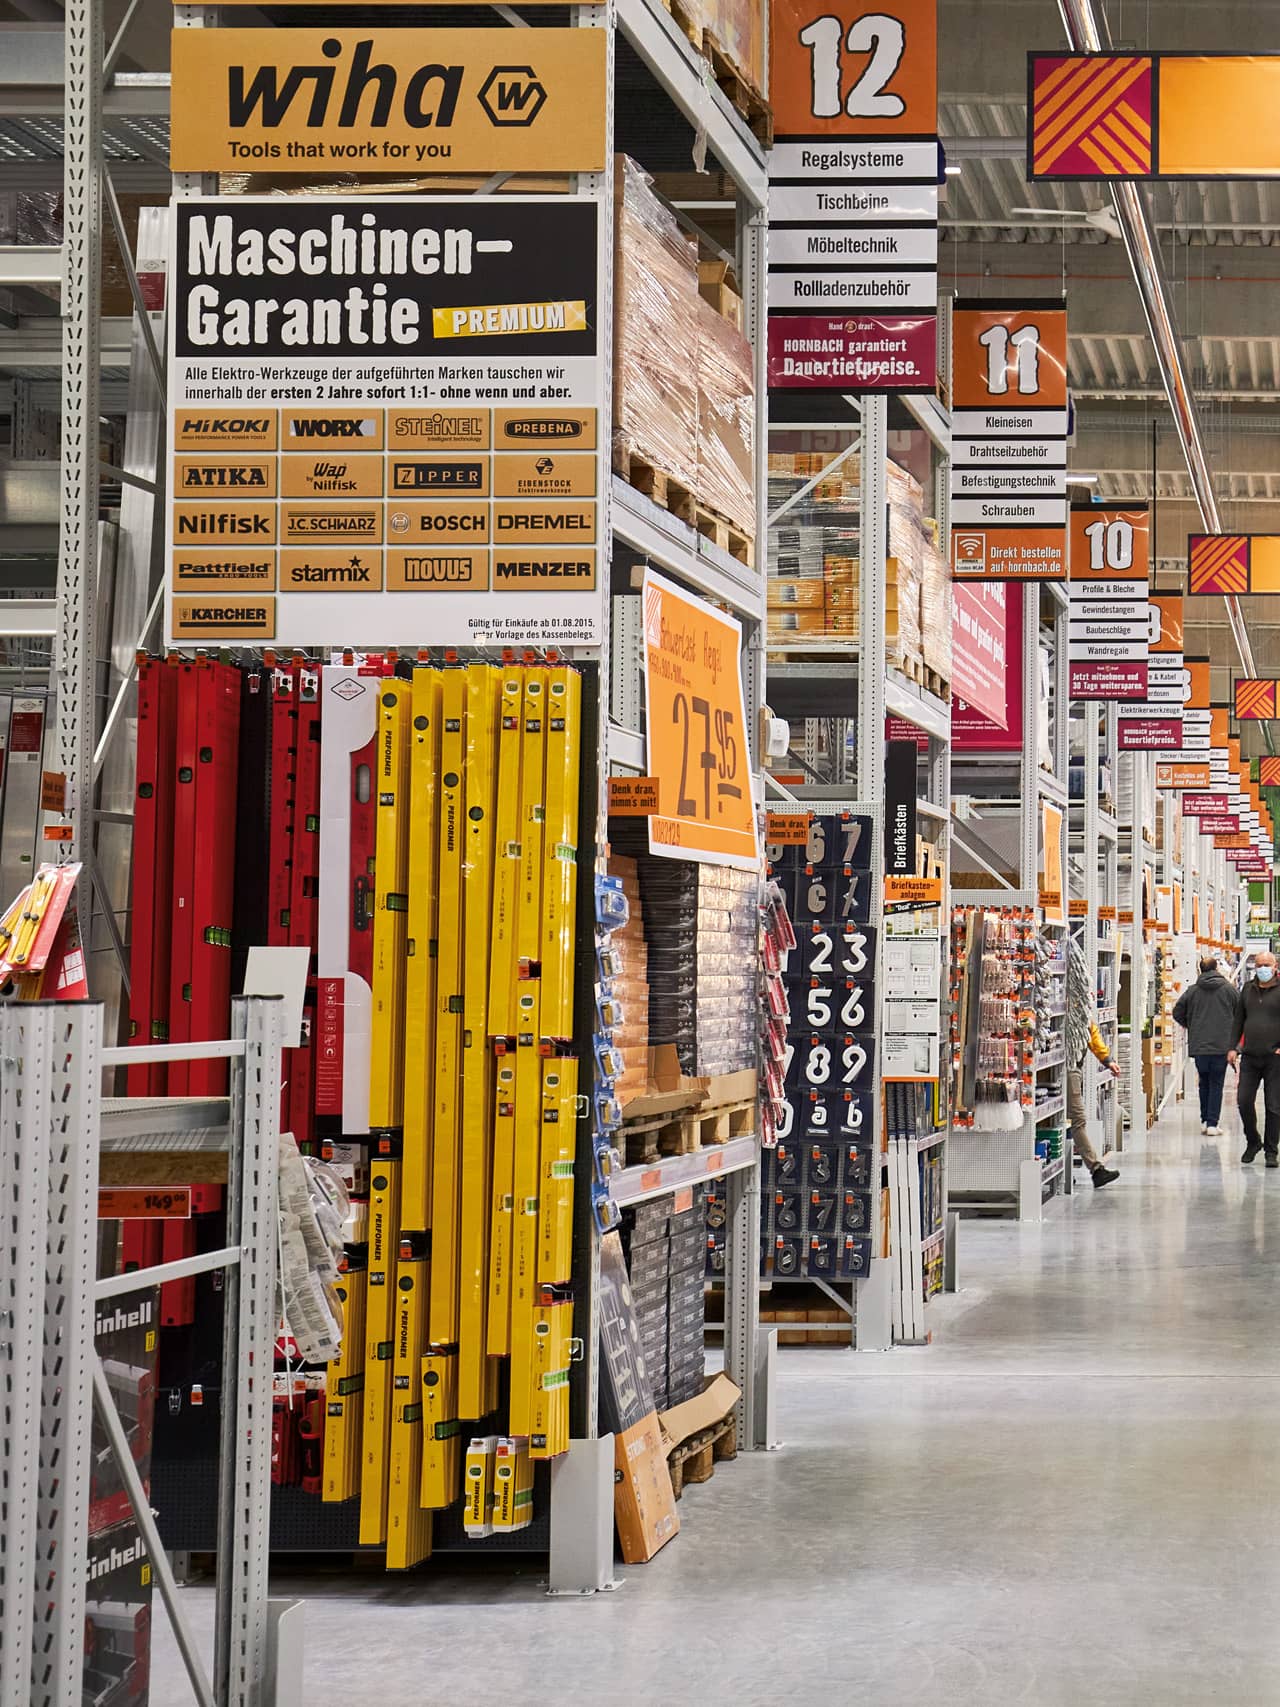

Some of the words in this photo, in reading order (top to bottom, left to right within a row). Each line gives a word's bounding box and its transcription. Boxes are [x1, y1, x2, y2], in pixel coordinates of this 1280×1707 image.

[799, 13, 905, 119] 12
[228, 38, 465, 128] wiha
[228, 142, 280, 158] Tools
[287, 142, 324, 158] that
[330, 142, 377, 158] work
[382, 142, 410, 158] for
[416, 145, 451, 161] you
[802, 150, 904, 169] Regalsysteme
[816, 194, 889, 210] Tischbeine
[187, 213, 513, 276] Maschinen-
[807, 237, 897, 253] Möbeltechnik
[794, 280, 911, 296] Rollladenzubehör
[187, 282, 420, 346] Garantie
[452, 304, 566, 335] PREMIUM
[784, 340, 843, 352] HORNBACH
[849, 339, 907, 355] garantiert
[978, 324, 1041, 395] 11
[185, 367, 207, 380] Alle
[212, 367, 328, 382] Elektro-Werkzeuge
[332, 367, 352, 380] der
[356, 366, 434, 382] aufgeführten
[438, 366, 483, 380] Marken
[487, 366, 542, 380] tauschen
[547, 366, 565, 380] wir
[784, 357, 920, 380] Dauertiefpreise.
[185, 386, 242, 399] innerhalb
[247, 386, 266, 399] der
[271, 387, 312, 399] ersten
[316, 386, 324, 399] 2
[328, 386, 362, 399] Jahre
[367, 385, 406, 399] sofort
[440, 385, 471, 398] ohne
[475, 388, 508, 398] wenn
[512, 385, 535, 398] und
[540, 385, 572, 398] aber.
[182, 420, 270, 433] HiKOKI
[293, 419, 364, 437] WORX
[514, 423, 574, 433] PREBENA
[985, 416, 1032, 428] Kleineisen
[970, 446, 1048, 457] Drahtseilzubehör
[185, 468, 266, 485] ATIKA
[314, 463, 347, 479] Wap
[400, 469, 479, 484] ZIPPER
[314, 480, 357, 490] Nilfisk
[961, 475, 1056, 488] Befestigungstechnik
[981, 504, 1035, 516] Schrauben
[179, 514, 270, 533] Nilfisk
[420, 516, 485, 531] BOSCH
[497, 515, 591, 529] DREMEL
[991, 547, 1018, 558] Direkt
[1021, 547, 1061, 558] bestellen
[1085, 519, 1134, 571] 10
[179, 563, 270, 573] Pattfield
[291, 556, 370, 582] starmix
[497, 562, 590, 578] MENZER
[991, 561, 1005, 573] auf
[1008, 561, 1061, 573] hornbach.de
[1082, 585, 1105, 593] Profile
[1113, 585, 1135, 593] Bleche
[192, 608, 266, 620] KÄRCHER
[1082, 606, 1135, 615] Gewindestangen
[468, 619, 490, 629] Gültig
[492, 619, 503, 627] für
[505, 619, 538, 627] Einkäufe
[540, 619, 550, 627] ab
[551, 619, 595, 629] 01.08.2015,
[1086, 626, 1131, 635] Baubeschläge
[495, 631, 524, 640] Vorlage
[527, 631, 539, 639] des
[541, 631, 595, 640] Kassenbelegs.
[1088, 647, 1129, 656] Wandregale
[384, 731, 392, 776] PERFORMER
[612, 784, 631, 794] Denk
[635, 784, 655, 795] dran,
[640, 797, 657, 807] mit!
[894, 804, 907, 868] Briefkästen
[891, 881, 935, 890] Briefkasten-
[900, 890, 926, 900] anlagen
[809, 934, 833, 972] 2
[842, 934, 868, 972] 3
[807, 989, 833, 1027] 5
[841, 989, 865, 1027] 6
[806, 1046, 831, 1085] 8
[841, 1045, 867, 1083] 9
[401, 1310, 409, 1358] PERFORMER
